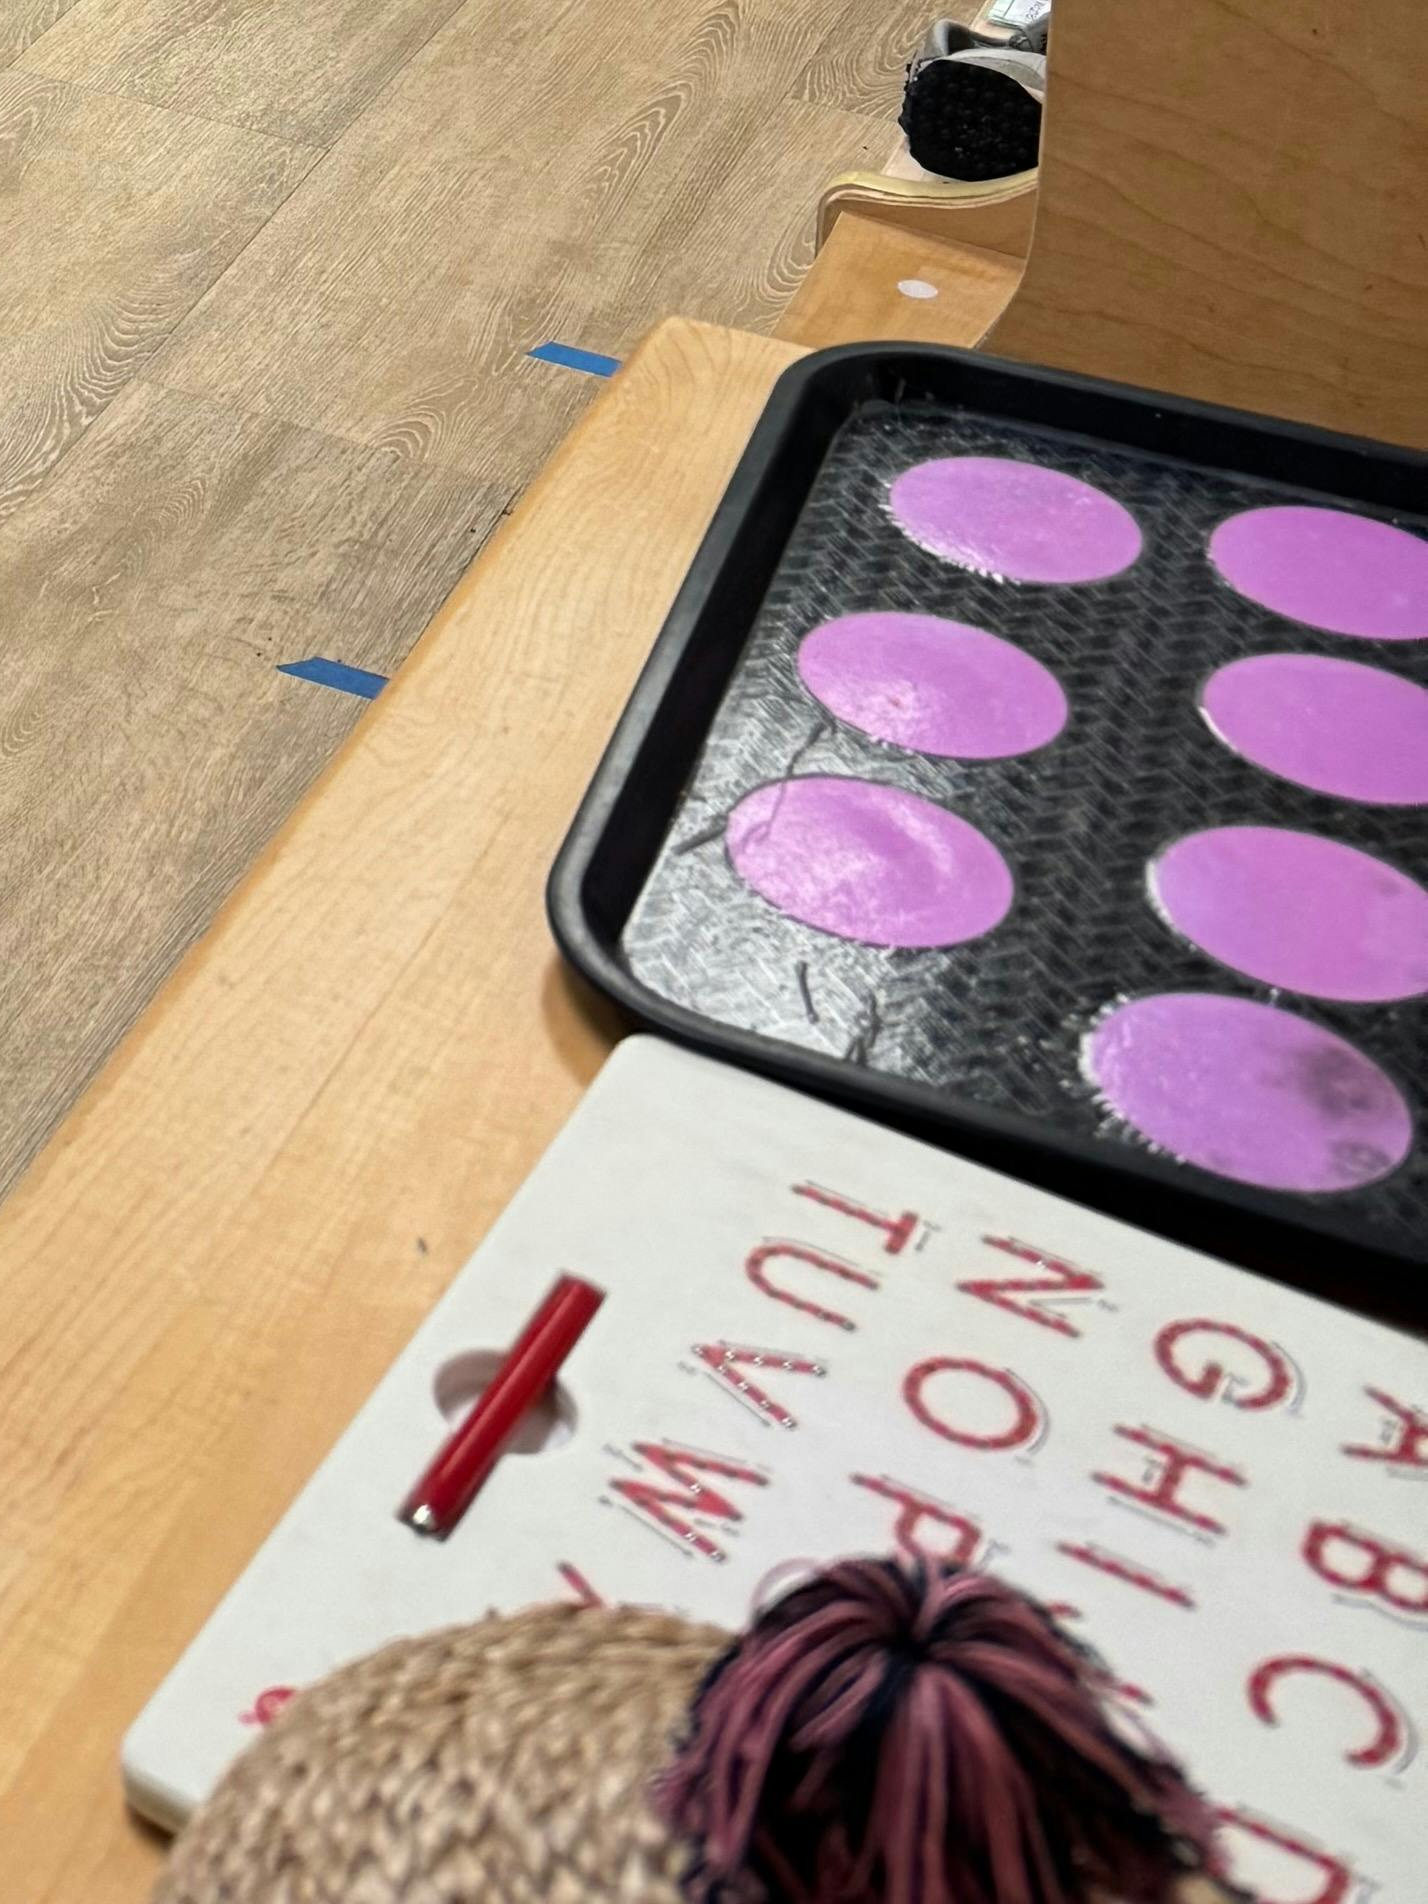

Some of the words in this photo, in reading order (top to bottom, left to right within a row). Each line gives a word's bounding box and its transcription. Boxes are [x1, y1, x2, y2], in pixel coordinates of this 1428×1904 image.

[789, 1180, 920, 1258] T
[744, 1240, 882, 1335] U
[954, 1232, 1107, 1341] N
[690, 1342, 828, 1431] V
[901, 1356, 1041, 1452] O
[1153, 1316, 1295, 1414] G
[607, 1439, 772, 1565] W
[1091, 1422, 1250, 1538] H
